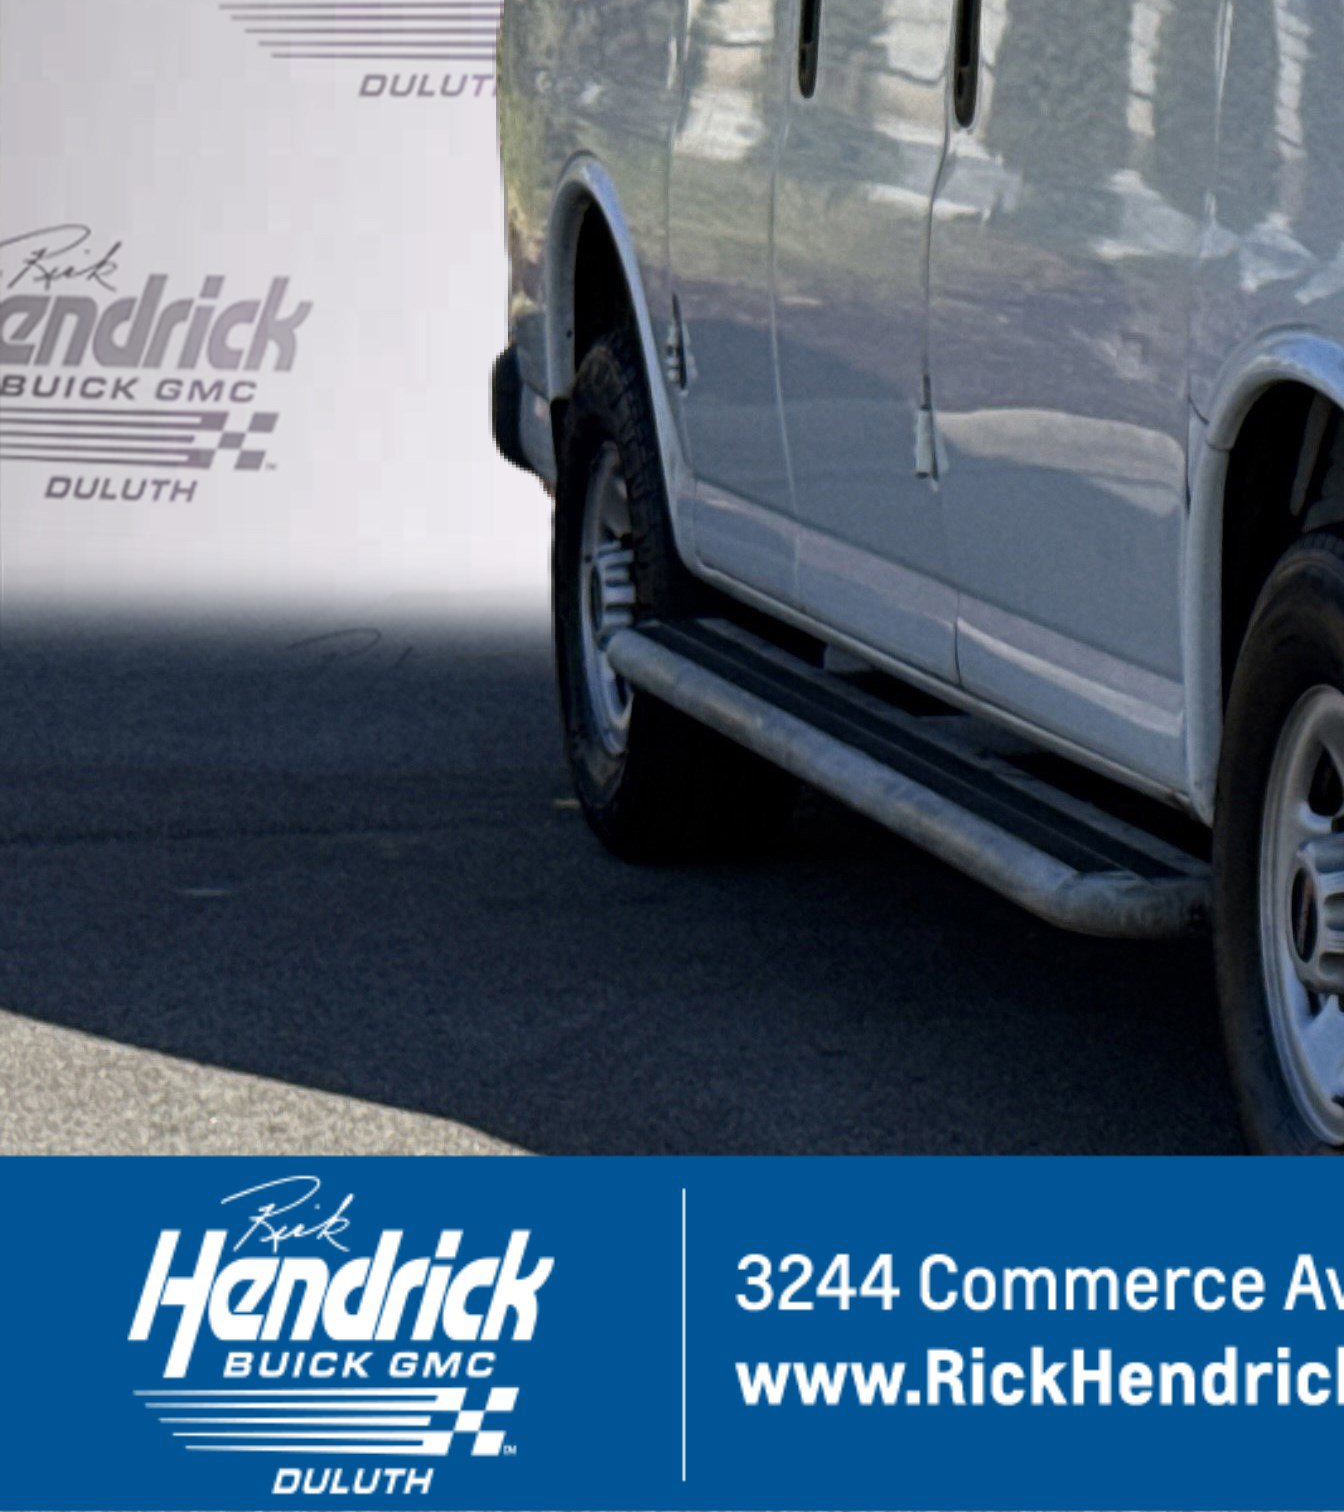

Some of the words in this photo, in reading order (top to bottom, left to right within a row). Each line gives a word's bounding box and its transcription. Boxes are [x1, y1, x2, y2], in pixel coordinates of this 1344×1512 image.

[358, 74, 498, 97] DULUT
[0, 273, 313, 371] endrick
[0, 375, 139, 400] BUICK
[154, 380, 257, 403] GMC
[45, 477, 197, 502] DULUTH
